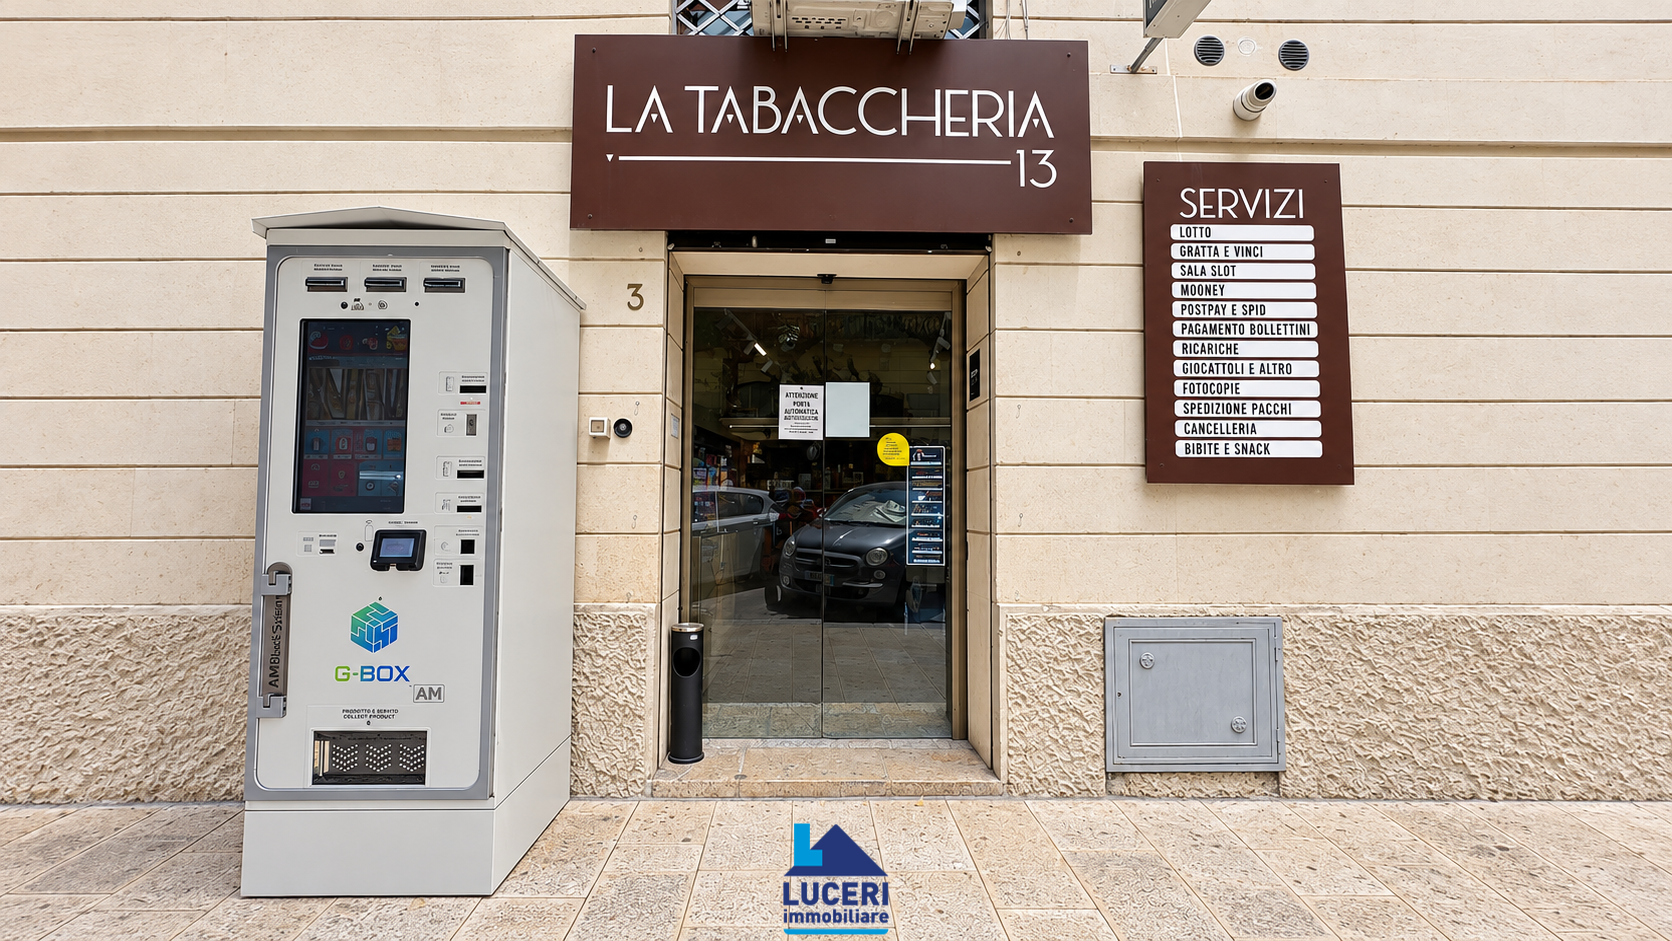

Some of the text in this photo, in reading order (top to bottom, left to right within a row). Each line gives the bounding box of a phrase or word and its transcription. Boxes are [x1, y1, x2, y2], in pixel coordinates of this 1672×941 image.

[606, 85, 1055, 138] LA TABACCHERIA
[1015, 149, 1058, 188] 13
[1179, 187, 1304, 219] SERVIZI
[1179, 226, 1212, 239] LOTTO
[1179, 245, 1263, 258] GRATTA E VINCI
[1180, 264, 1237, 277] SALA SLOT
[1180, 283, 1225, 297] MOONEY
[626, 283, 645, 311] 3
[1180, 303, 1266, 316] POSTPAY E SPID
[1181, 322, 1311, 336] PAGAMENTO BOLLETTINI
[1181, 342, 1239, 355] RICARICHE
[1182, 362, 1292, 375] GIOCATTOLI E ALTRO
[1182, 382, 1241, 395] FOTOCOPIE
[1183, 402, 1292, 415] SPEDIZIONE PACCHI
[1183, 422, 1258, 435] CANCELLERIA
[1184, 442, 1271, 456] BIBITE E SNACK
[334, 665, 410, 682] G-BOX
[415, 686, 442, 701] AM
